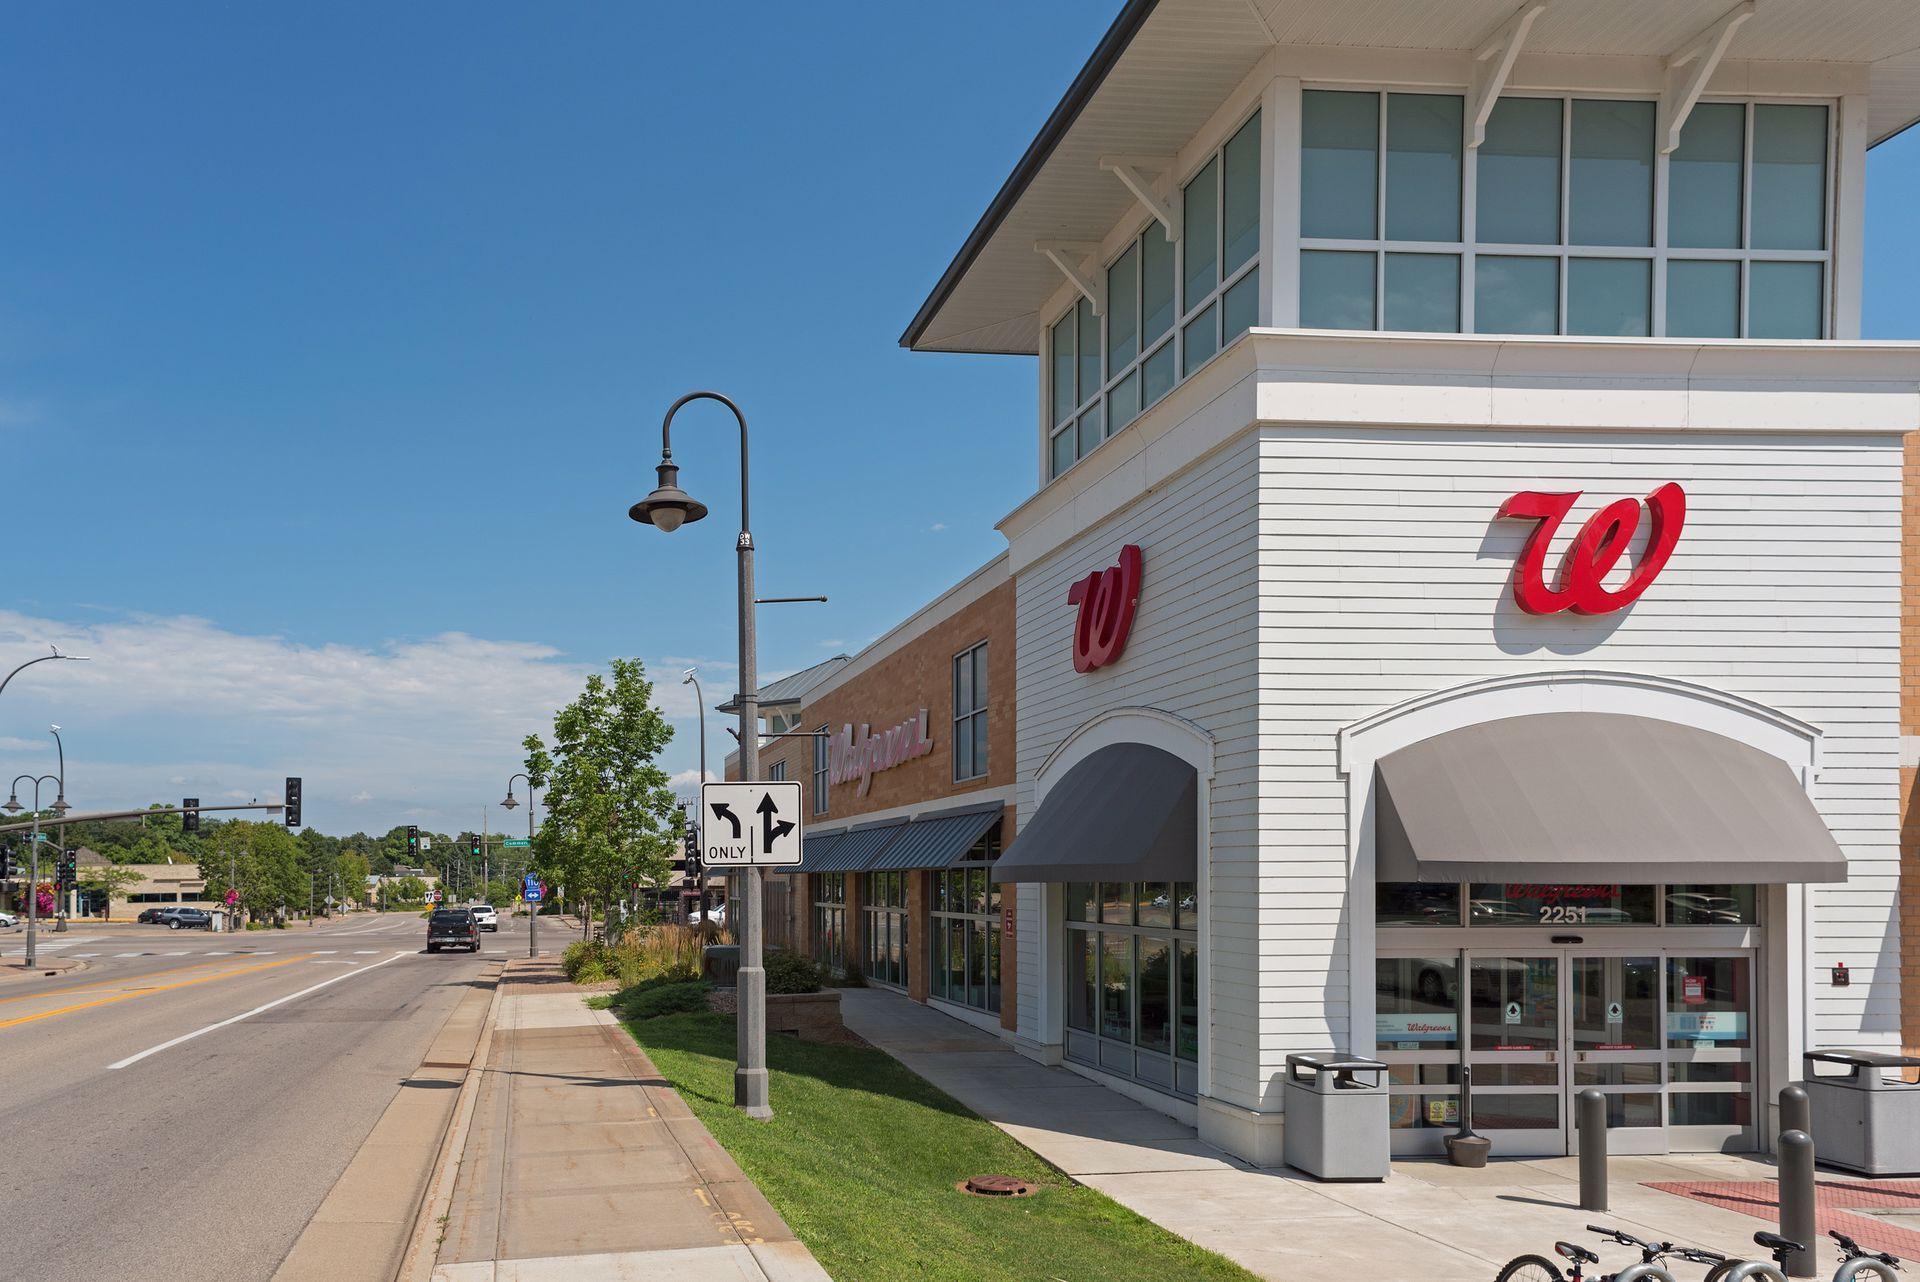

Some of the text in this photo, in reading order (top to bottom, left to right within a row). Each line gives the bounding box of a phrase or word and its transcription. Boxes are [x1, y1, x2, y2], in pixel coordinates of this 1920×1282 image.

[709, 846, 746, 859] ONLY
[1540, 906, 1586, 924] 2251
[1407, 1023, 1453, 1034] Walgreens
